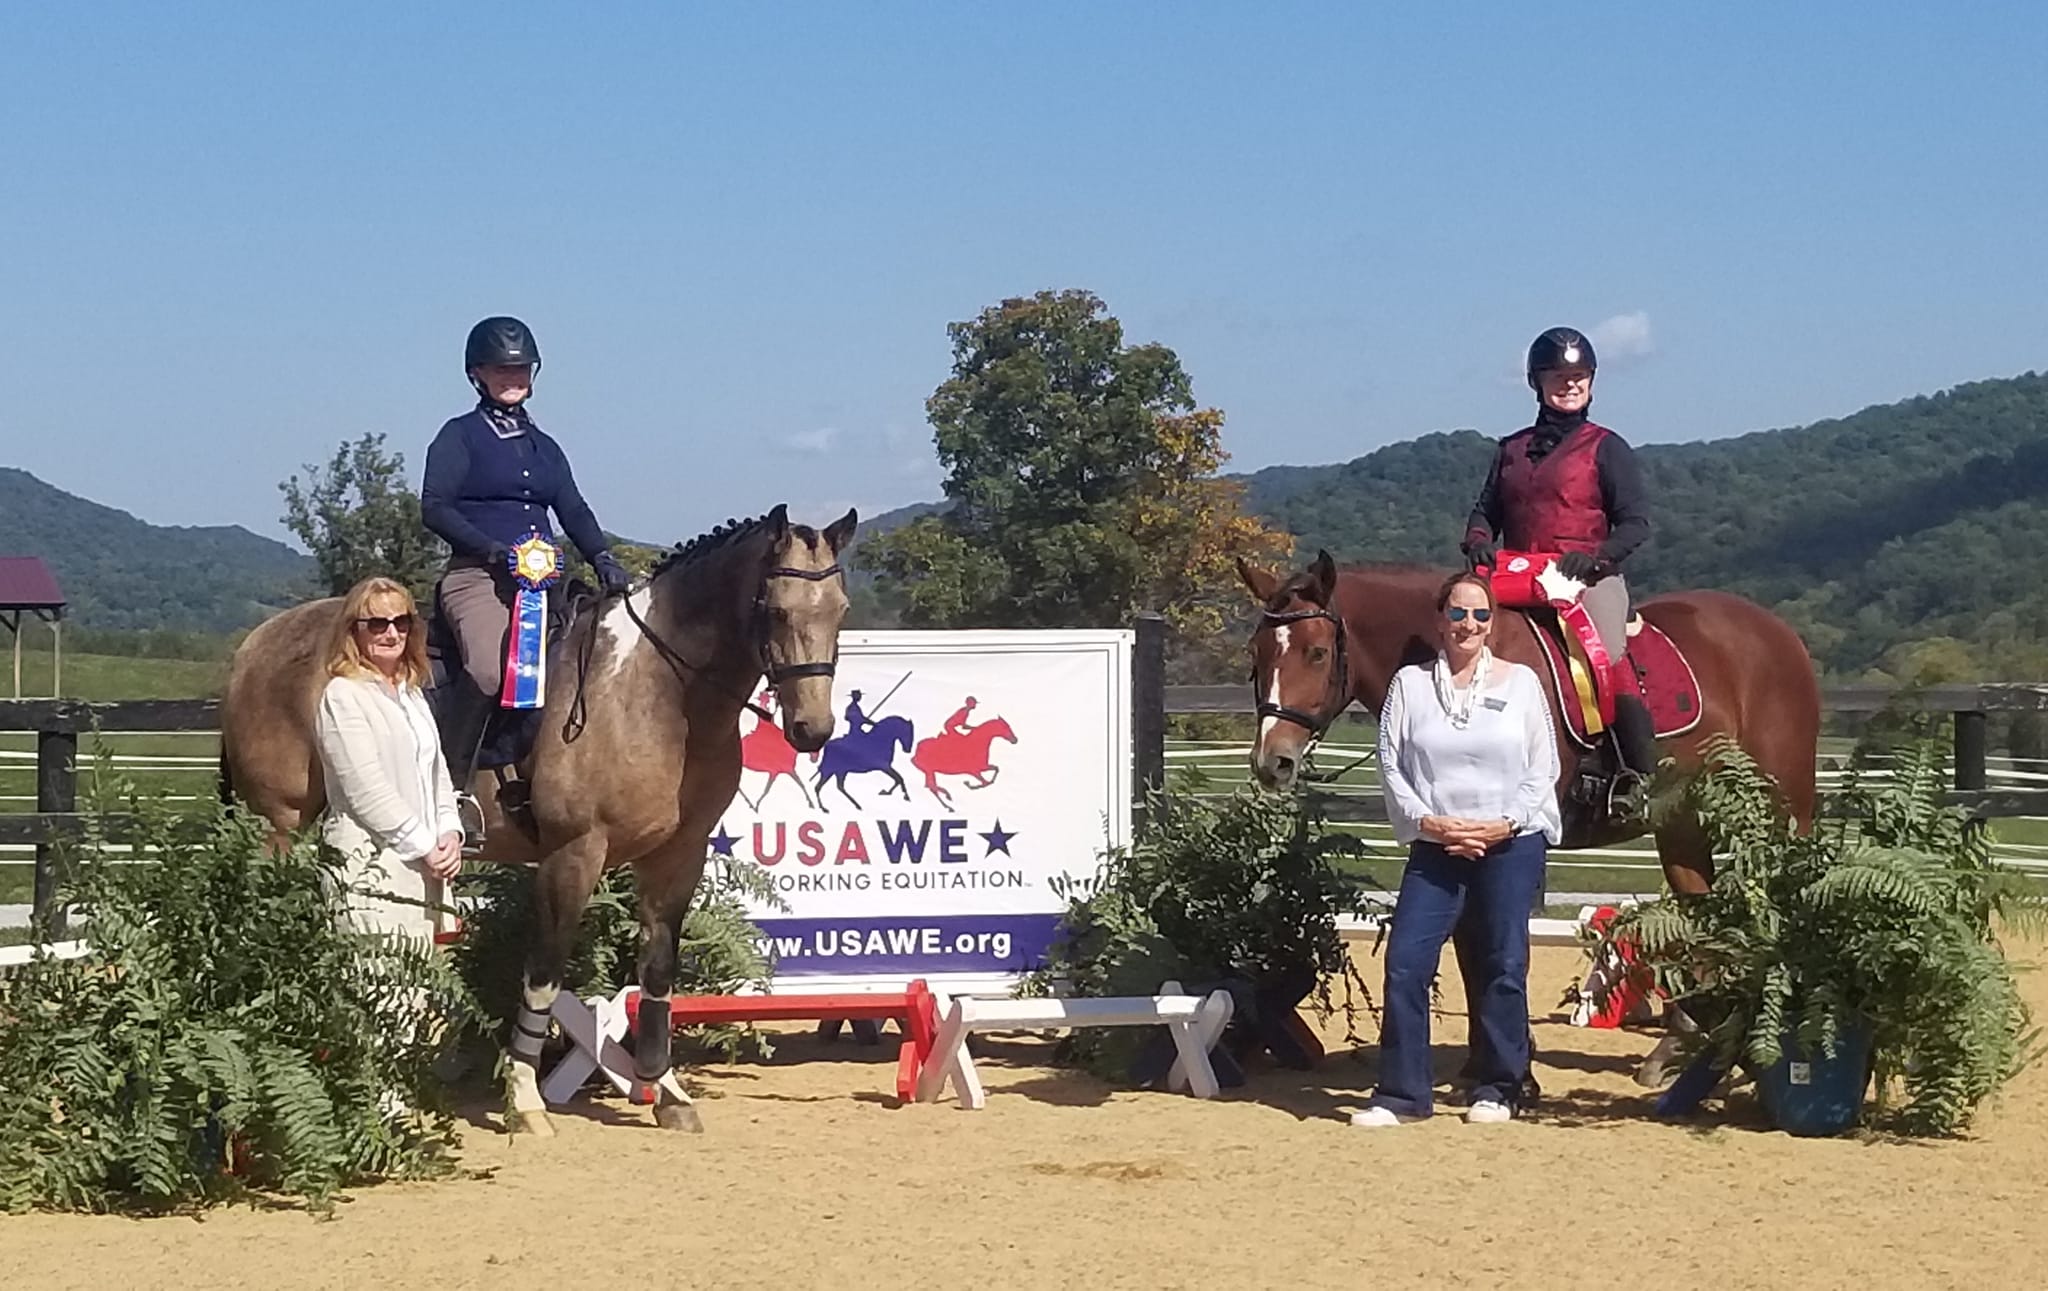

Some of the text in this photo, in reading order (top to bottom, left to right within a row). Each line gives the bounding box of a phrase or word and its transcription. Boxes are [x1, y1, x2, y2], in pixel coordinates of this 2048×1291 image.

[752, 819, 969, 866] USAWE
[770, 872, 871, 892] ORKING
[881, 870, 1023, 890] EQUITATION
